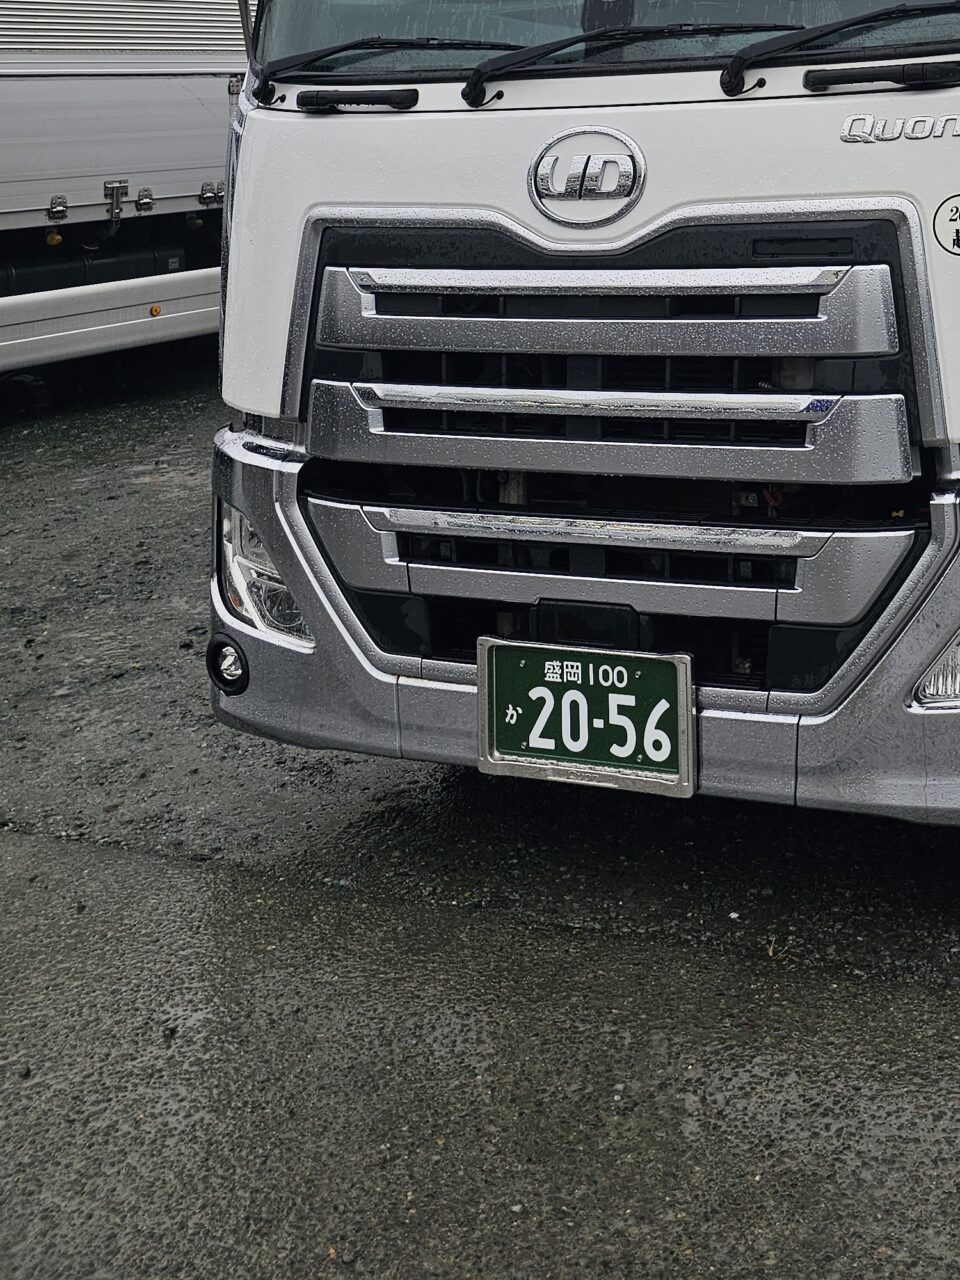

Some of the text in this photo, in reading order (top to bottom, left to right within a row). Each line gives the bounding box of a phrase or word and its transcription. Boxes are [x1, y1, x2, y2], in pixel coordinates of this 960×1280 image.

[537, 153, 634, 201] UD
[544, 660, 628, 688] 盛岡 100
[505, 686, 672, 762] か 20-56
